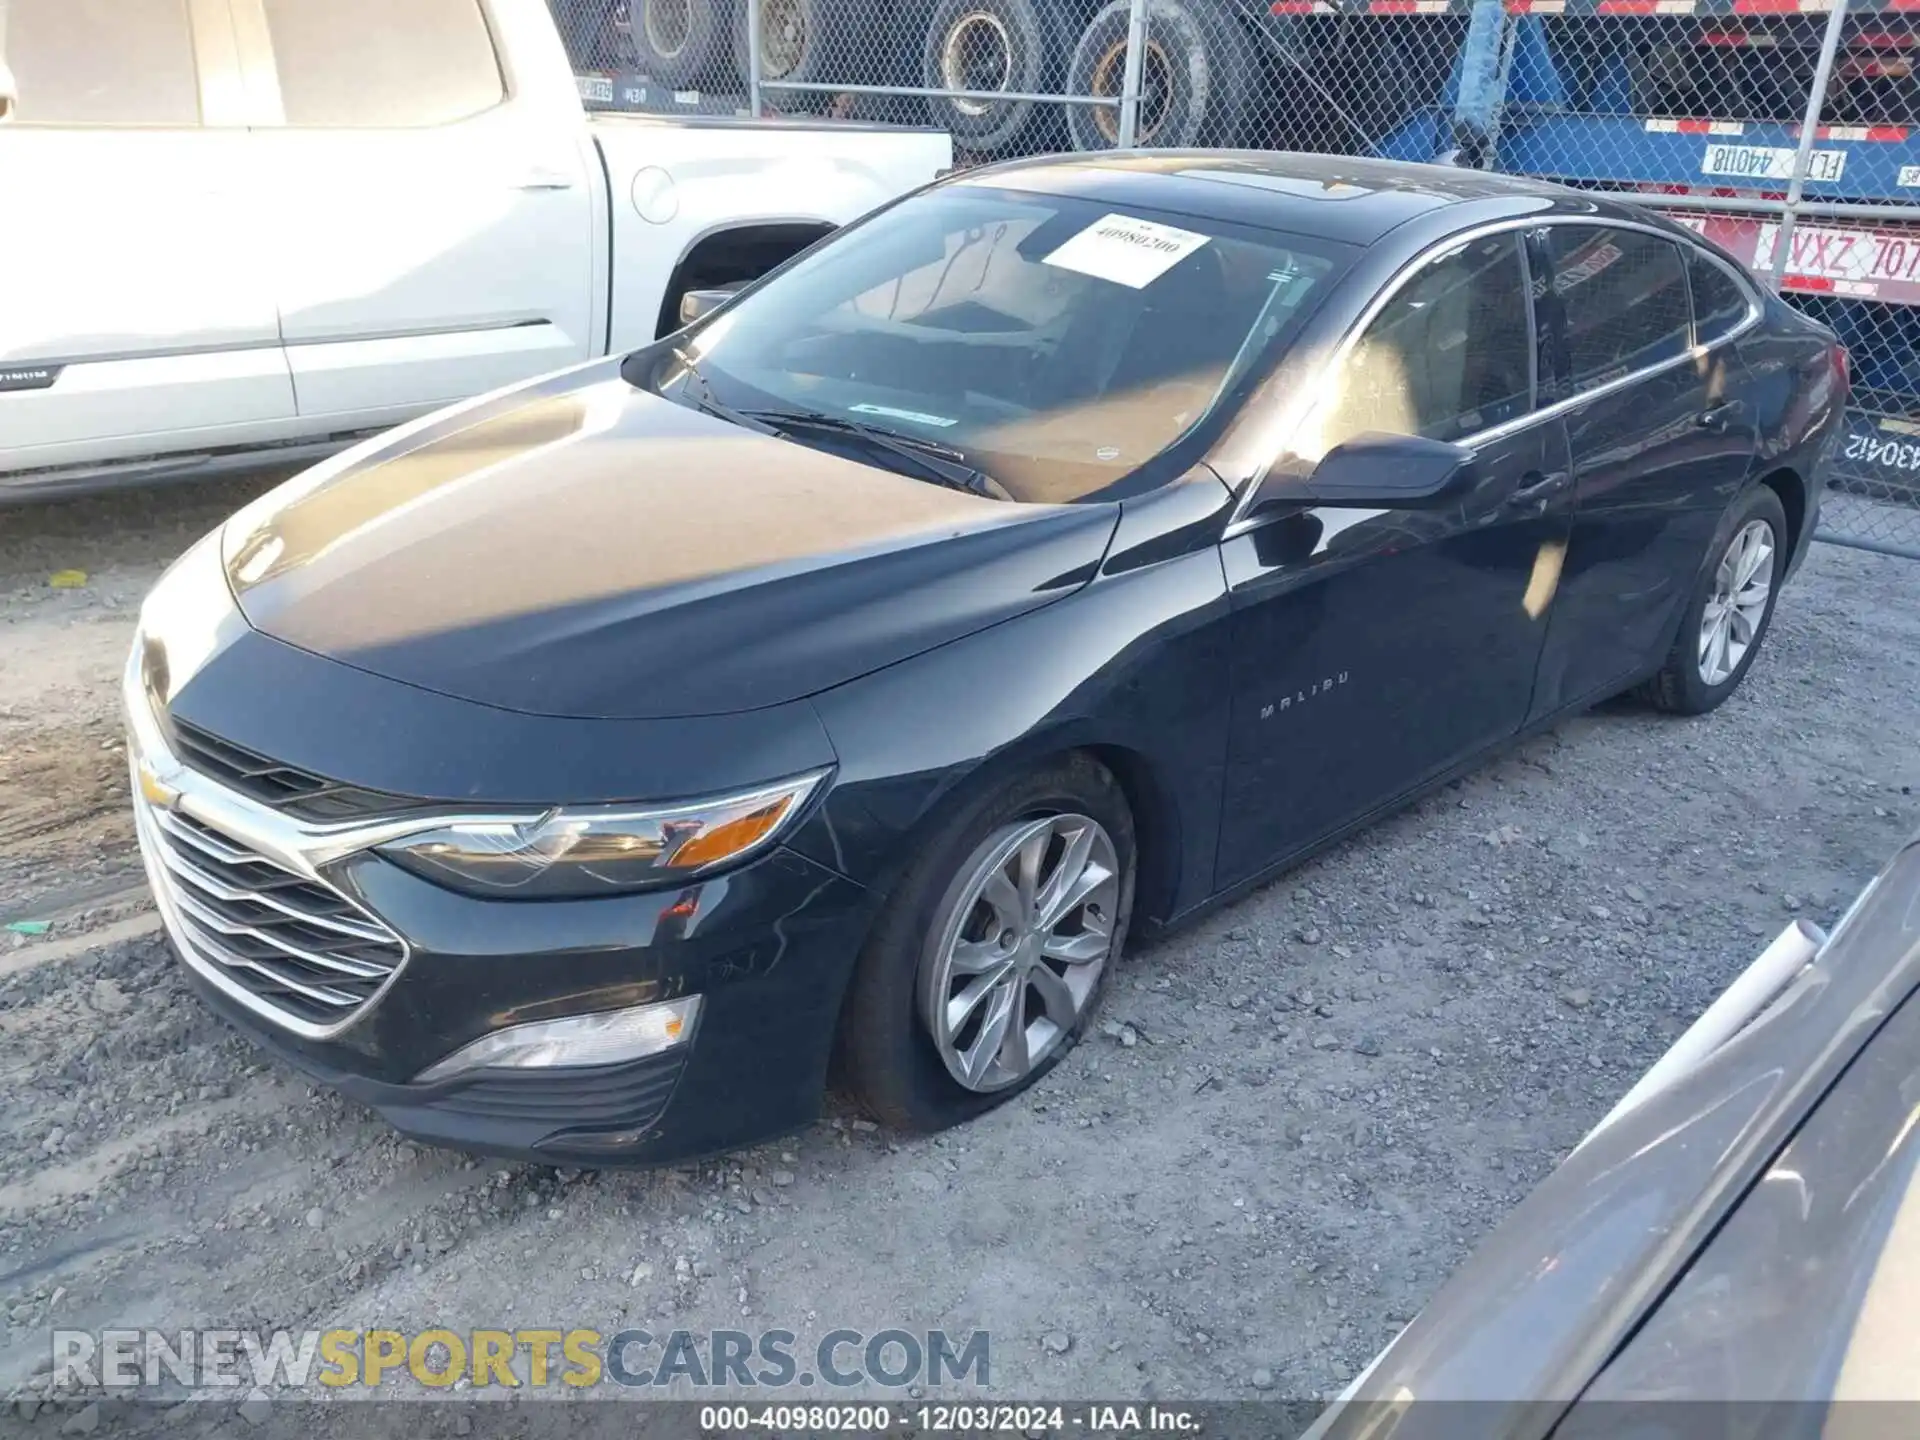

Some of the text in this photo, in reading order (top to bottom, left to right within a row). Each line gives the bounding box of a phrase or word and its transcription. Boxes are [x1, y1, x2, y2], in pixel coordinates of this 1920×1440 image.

[1805, 152, 1841, 180] FLT
[1097, 227, 1180, 252] 40980200
[1261, 671, 1348, 719] MALIBU
